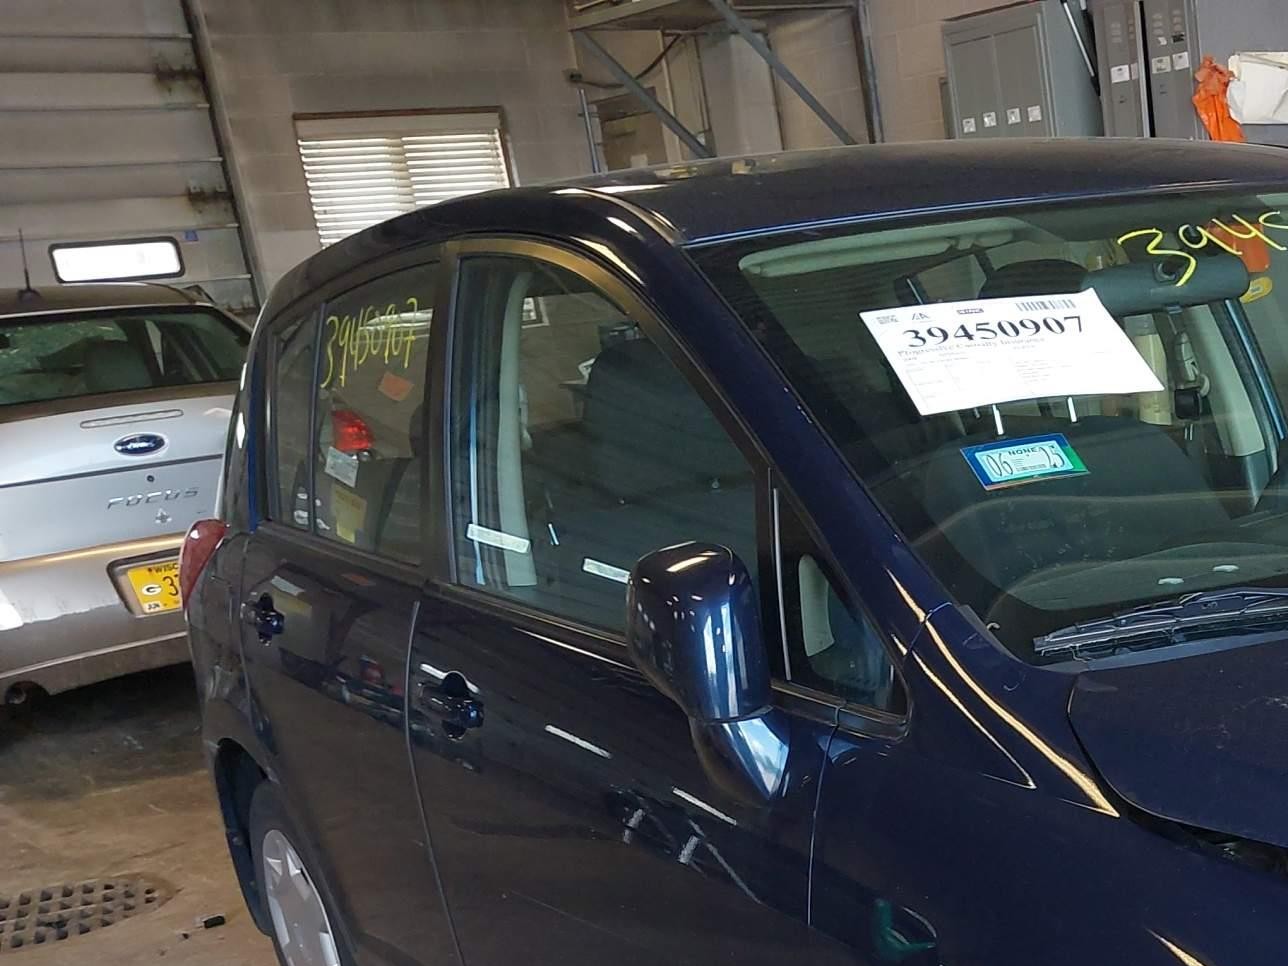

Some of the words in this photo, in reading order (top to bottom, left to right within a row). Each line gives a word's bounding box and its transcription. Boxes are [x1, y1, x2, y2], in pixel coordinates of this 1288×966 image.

[320, 298, 418, 388] 39450907
[902, 315, 1084, 348] 39450907
[986, 453, 1013, 476] 06
[107, 487, 200, 509] FOCUS
